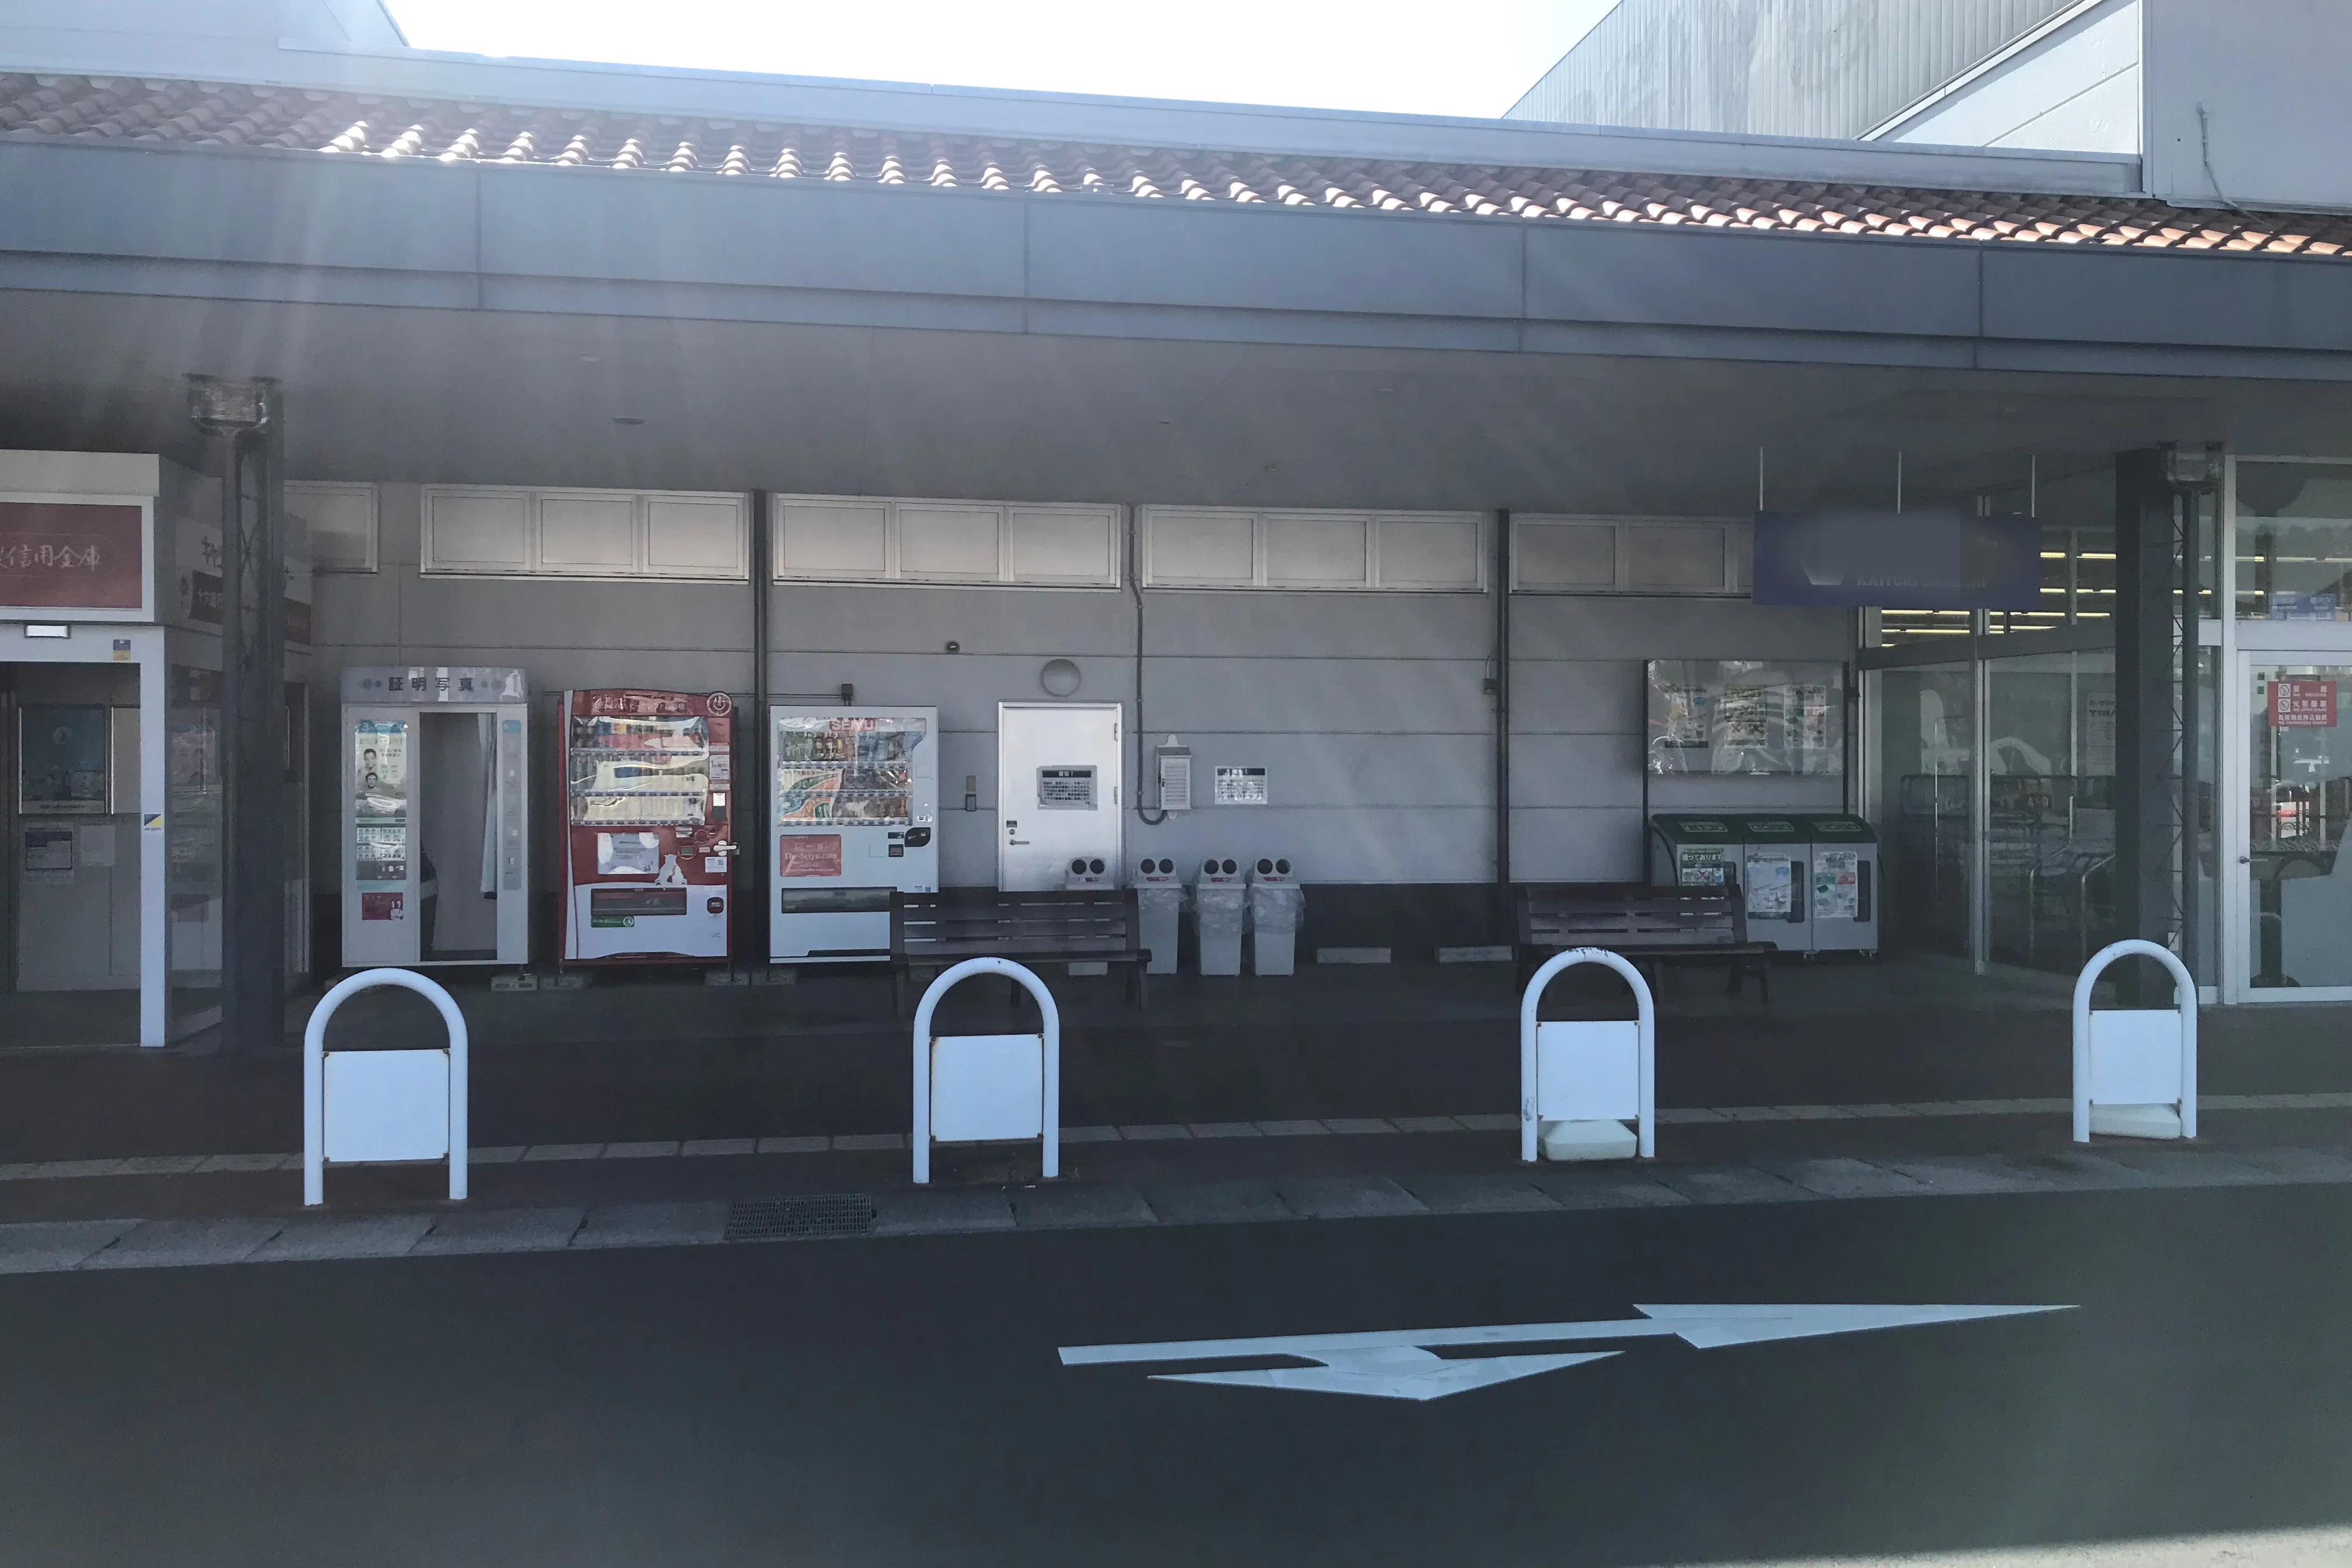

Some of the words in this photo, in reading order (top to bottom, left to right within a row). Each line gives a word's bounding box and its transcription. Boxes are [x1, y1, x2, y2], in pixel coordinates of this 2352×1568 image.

[388, 677, 474, 691] 証明写真
[831, 719, 874, 730] SEIYU
